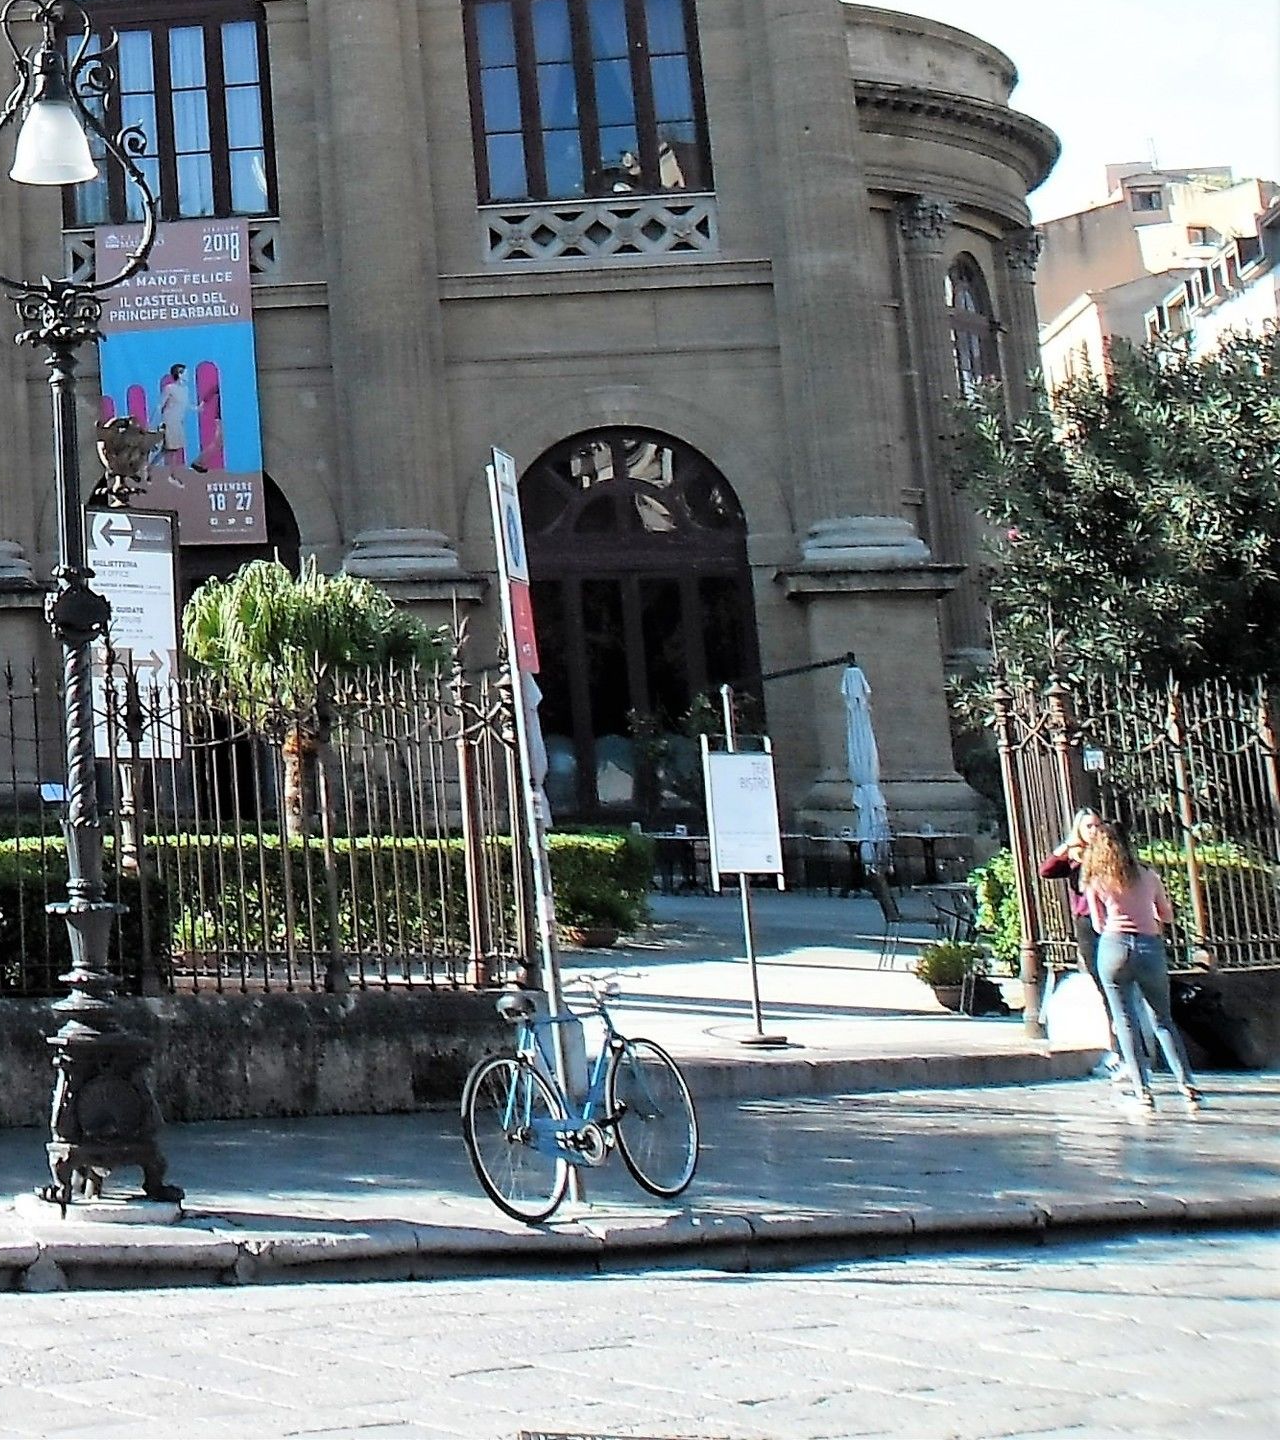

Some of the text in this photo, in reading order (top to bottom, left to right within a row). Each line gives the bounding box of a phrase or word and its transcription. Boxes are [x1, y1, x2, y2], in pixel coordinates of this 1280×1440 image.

[202, 232, 240, 262] 2018
[136, 274, 178, 288] MANO
[183, 271, 233, 285] FELICE
[119, 291, 227, 309] IL CASTELLO DEL
[109, 307, 167, 323] PRINCIPE
[206, 482, 252, 491] NOVEMBRE
[208, 492, 252, 512] 18 27
